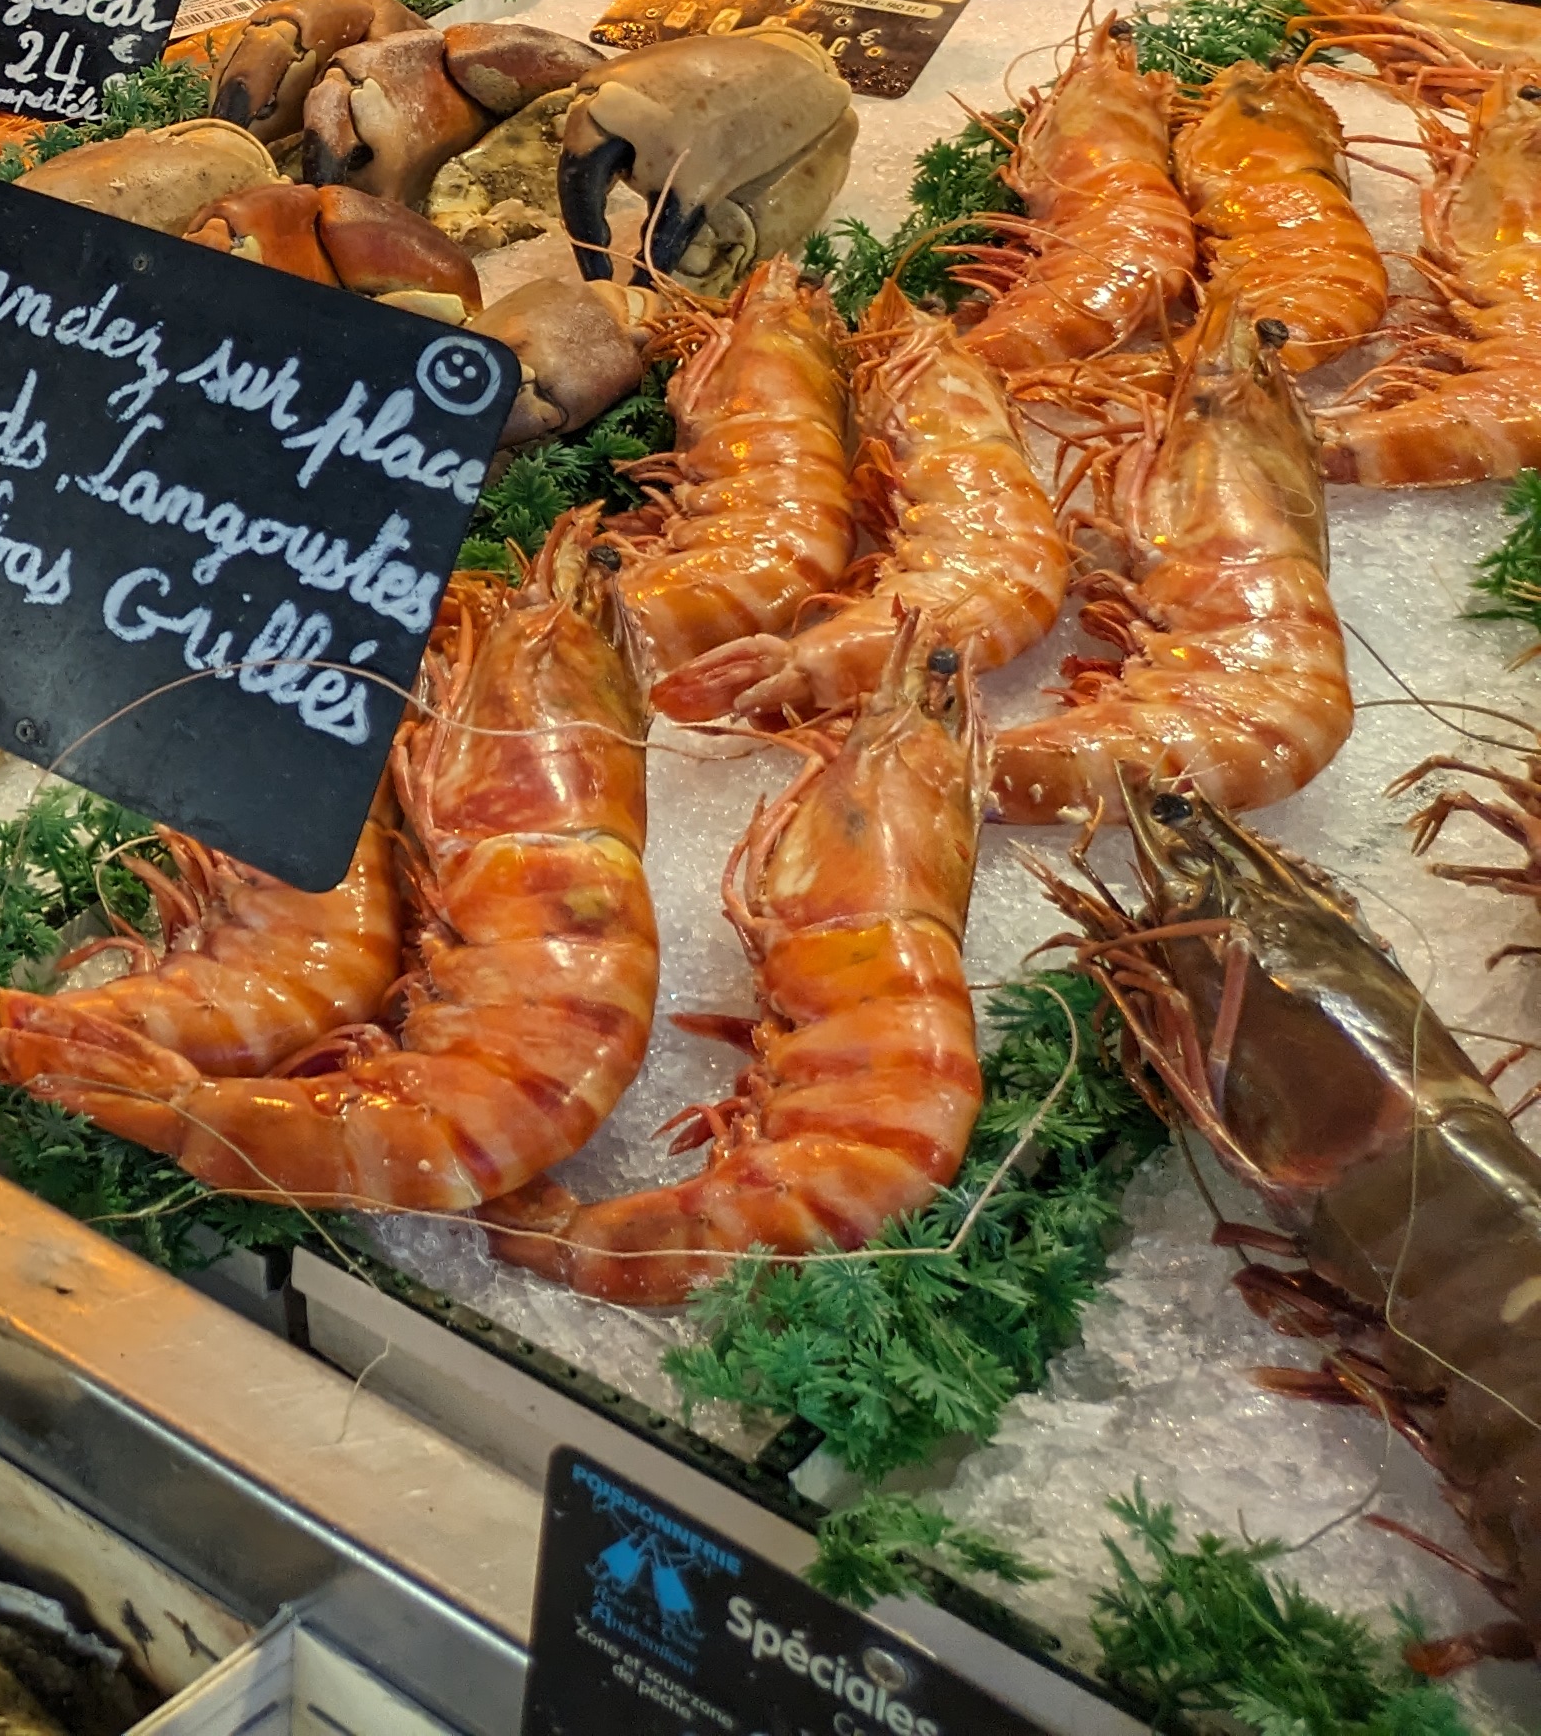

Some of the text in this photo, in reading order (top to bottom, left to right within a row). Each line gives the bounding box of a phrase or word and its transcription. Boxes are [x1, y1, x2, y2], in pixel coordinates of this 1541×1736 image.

[4, 30, 143, 87] 24 €
[857, 28, 881, 47] €
[176, 336, 305, 432] sur
[283, 379, 488, 505] place
[100, 562, 374, 746] Grillés
[572, 1463, 743, 1579] POISSONNERIE
[573, 1614, 621, 1657] Zone
[622, 1650, 642, 1669] et
[643, 1660, 735, 1731] sous-zone
[611, 1662, 695, 1722] de pêche
[724, 1593, 940, 1736] Spéciales
